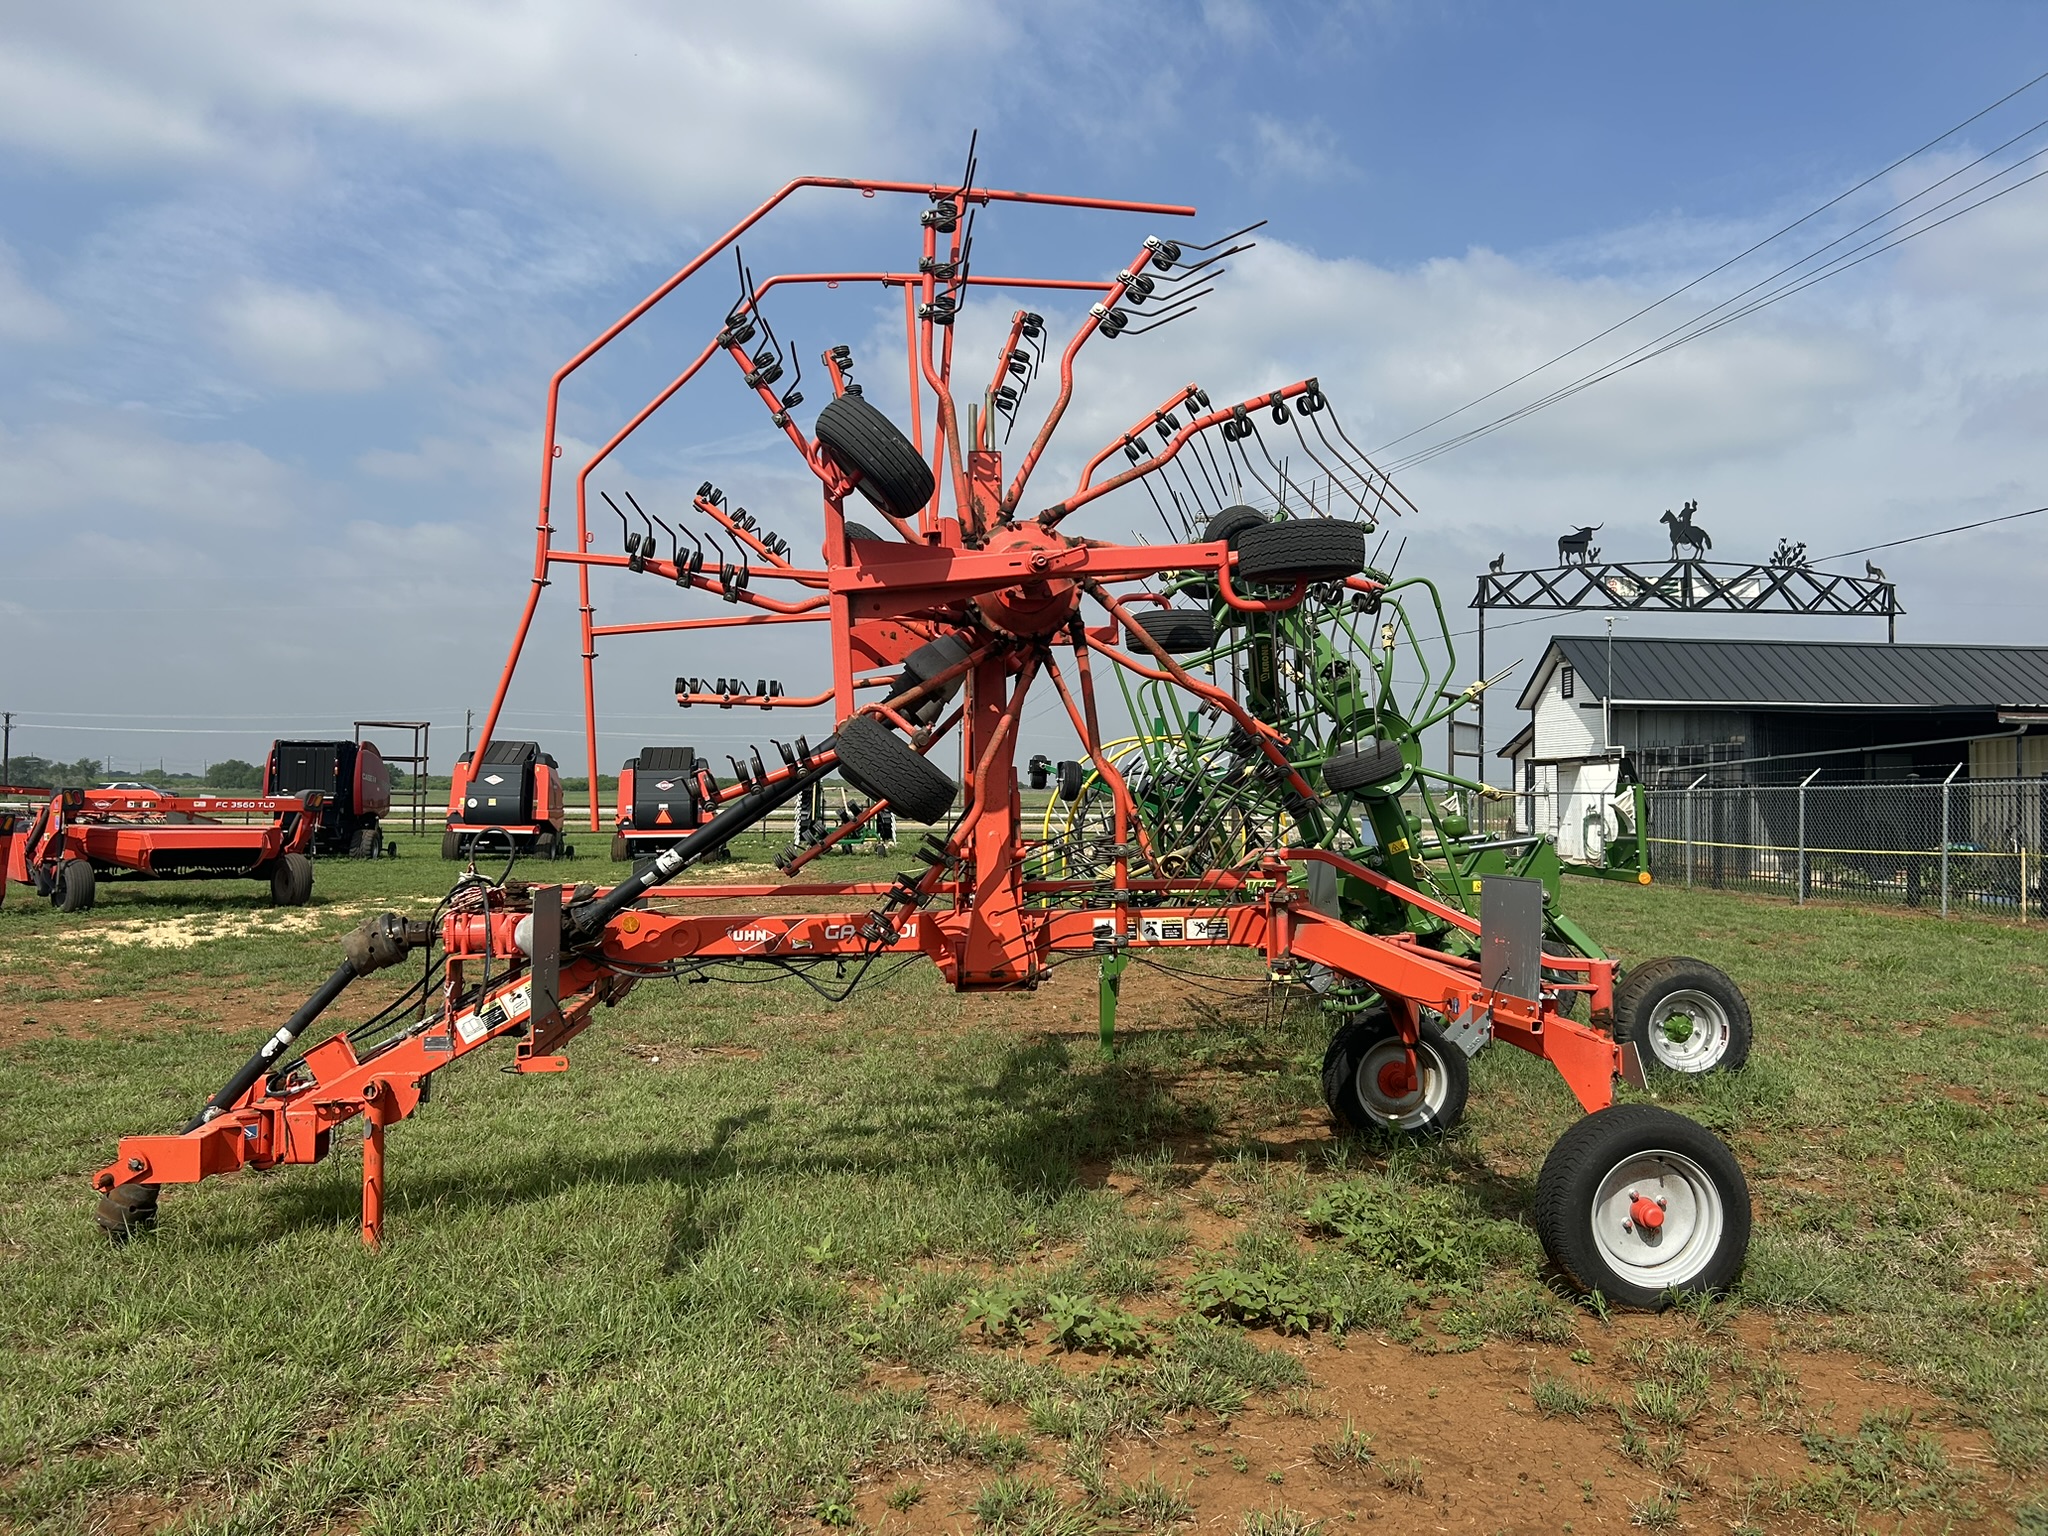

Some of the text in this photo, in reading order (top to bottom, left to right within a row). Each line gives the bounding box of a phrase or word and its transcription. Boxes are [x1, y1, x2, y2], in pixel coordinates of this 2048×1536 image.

[1261, 644, 1270, 672] KRONE
[231, 801, 256, 809] 3560
[729, 930, 767, 942] UHN
[825, 924, 856, 940] GA
